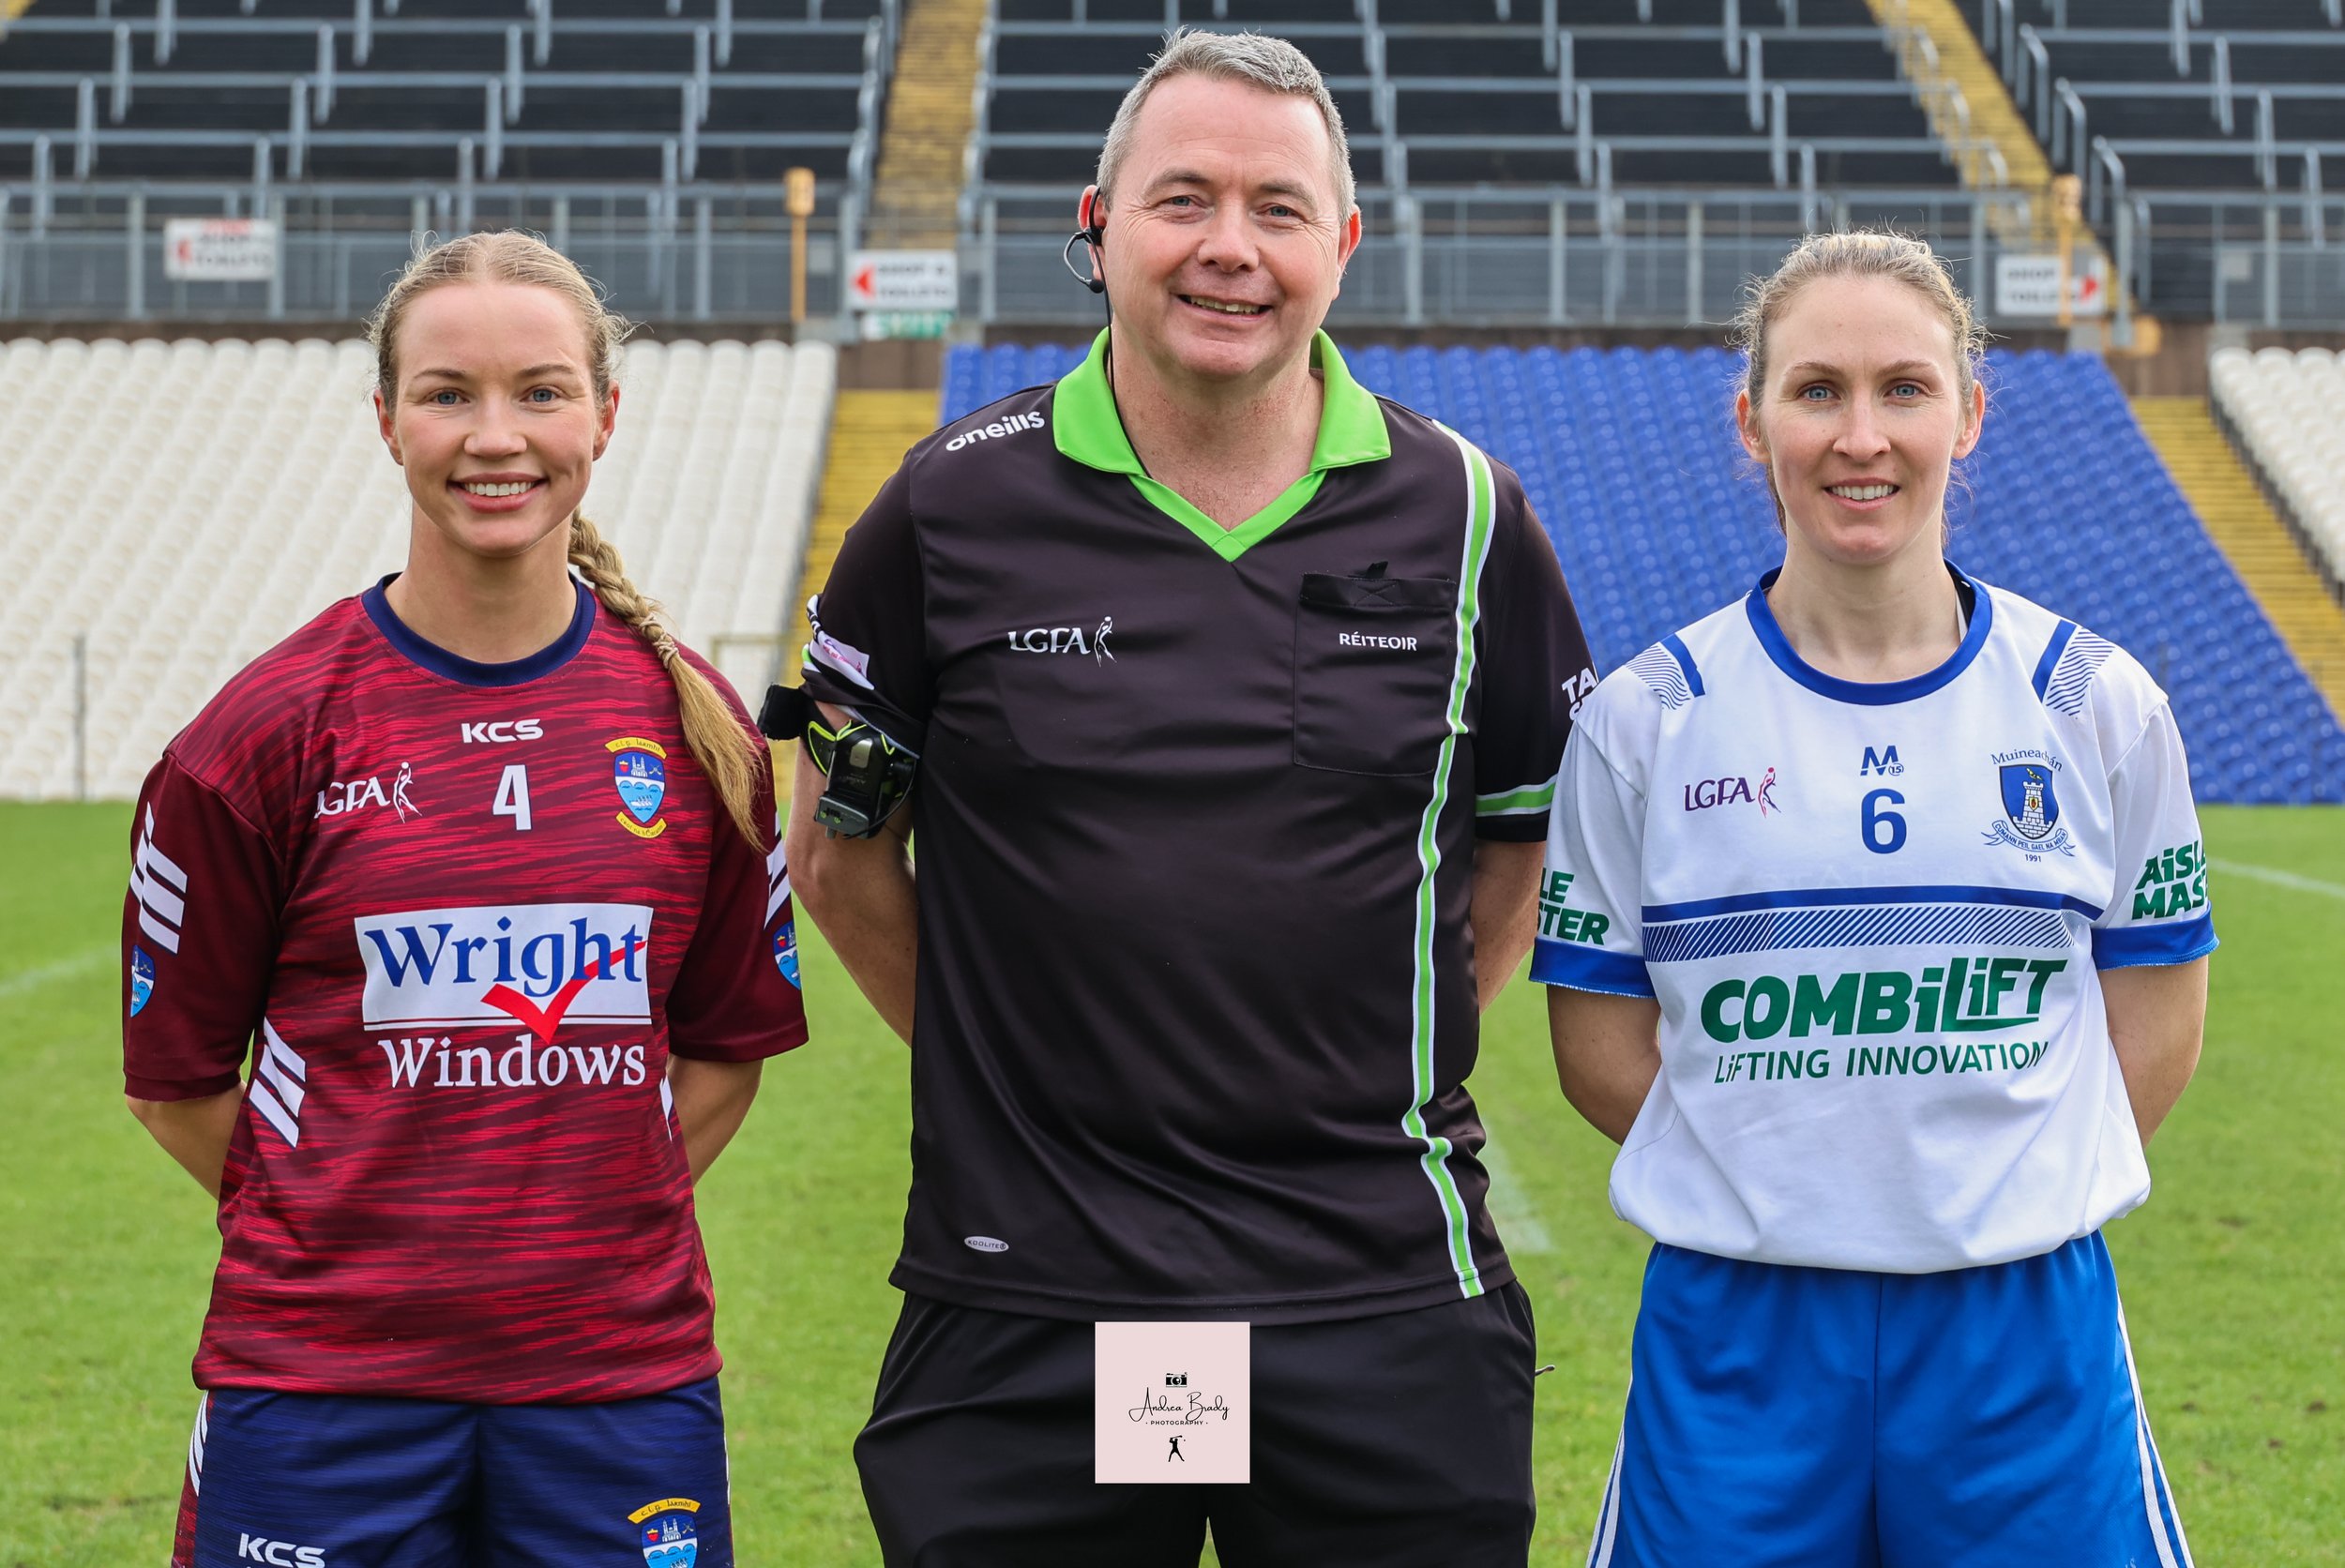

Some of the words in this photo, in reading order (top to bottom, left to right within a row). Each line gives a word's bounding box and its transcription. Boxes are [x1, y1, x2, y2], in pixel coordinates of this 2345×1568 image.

[1007, 627, 1091, 655] LGFA
[1339, 631, 1417, 651] RÉITEOIR
[461, 718, 544, 744] KCS
[1990, 748, 2063, 772] Muineachán
[492, 764, 532, 831] 4
[1685, 777, 1755, 812] LGFA
[1861, 788, 1907, 854] 6
[2024, 853, 2042, 863] 1991
[364, 915, 643, 997] Wright
[378, 1033, 646, 1088] Windows
[238, 1532, 325, 1568] KCS
